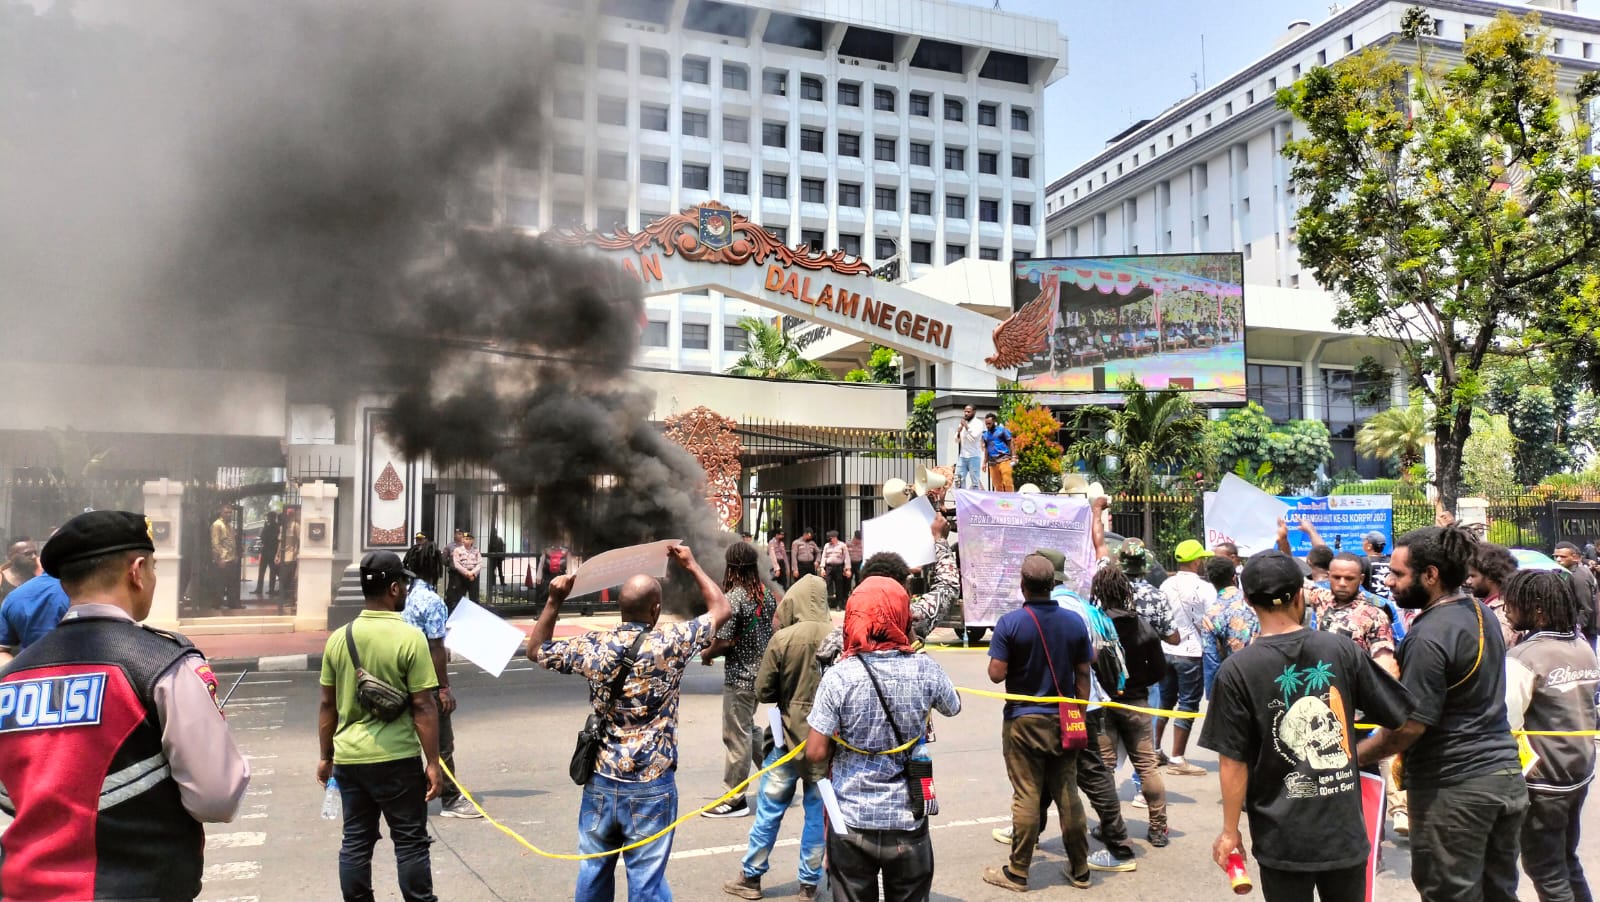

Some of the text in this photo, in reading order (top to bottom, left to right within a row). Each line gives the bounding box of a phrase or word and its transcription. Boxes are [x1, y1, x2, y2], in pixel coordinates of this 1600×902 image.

[764, 264, 953, 349] DALAM NEGERI
[1349, 513, 1373, 522] KORPRI
[0, 676, 101, 729] POLISI
